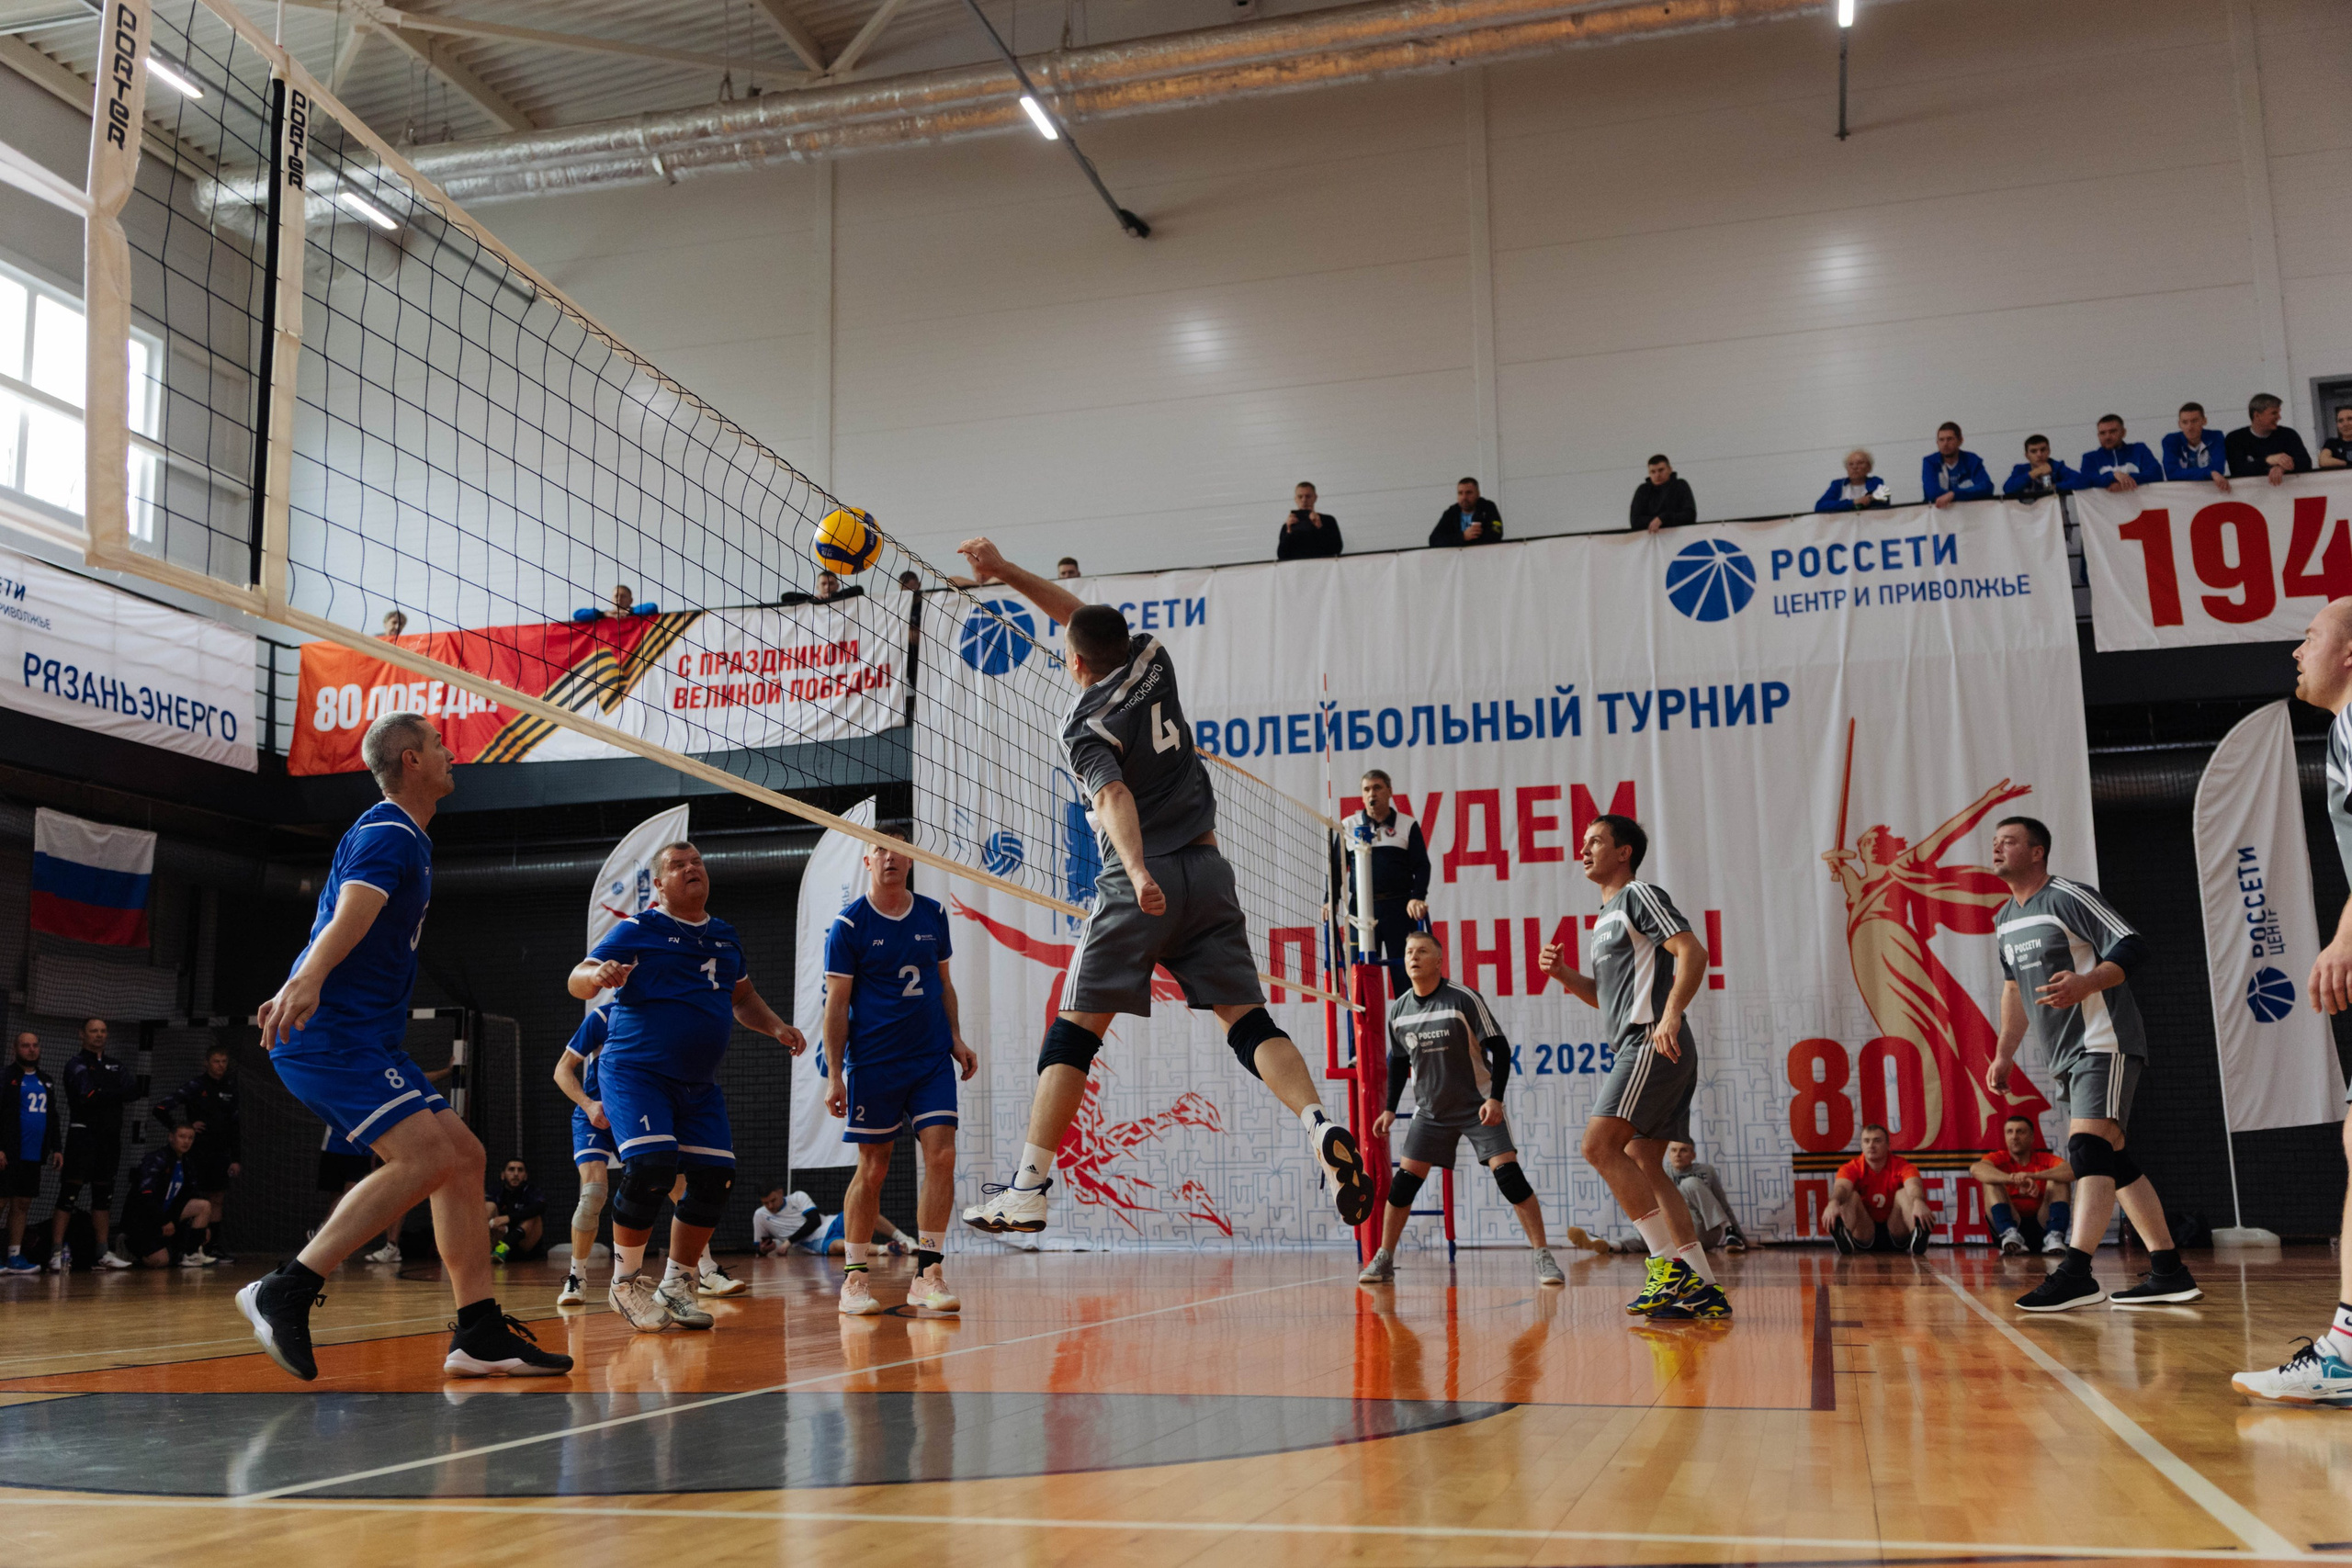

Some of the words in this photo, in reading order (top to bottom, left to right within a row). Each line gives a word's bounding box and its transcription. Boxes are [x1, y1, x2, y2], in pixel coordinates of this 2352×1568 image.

[1771, 534, 1958, 581] РОССЕТИ
[0, 577, 26, 602] ТИ
[1774, 590, 1847, 617] ЦЕНТР
[1855, 586, 1871, 607] И
[1879, 574, 2031, 604] ПРИВОЛЖЬЕ
[677, 654, 692, 678] С
[699, 639, 859, 677] ПРАЗДНИКОМ
[24, 652, 237, 741] РЯЗАНЬЭНЕРГО
[673, 679, 781, 709] ВЕЛИКОЙ
[789, 663, 892, 703] ПОБЕДЫ!
[313, 683, 363, 732] 80
[1195, 683, 1581, 761] ВОЛЕЙБОЛЬНЫЙ
[1598, 681, 1791, 734] ТУРНИР
[1150, 701, 1181, 754] 4
[2014, 938, 2041, 954] РОССЕТИ
[700, 957, 720, 991] 1
[898, 964, 924, 997] 2
[1419, 1029, 1450, 1041] РОССЕТИ
[1535, 1043, 1615, 1075] 2025
[384, 1067, 405, 1089] 8
[1787, 1035, 1928, 1154] 80
[28, 1092, 47, 1113] 22
[854, 1105, 865, 1122] 2
[586, 1133, 597, 1146] 7
[639, 1114, 650, 1132] 1
